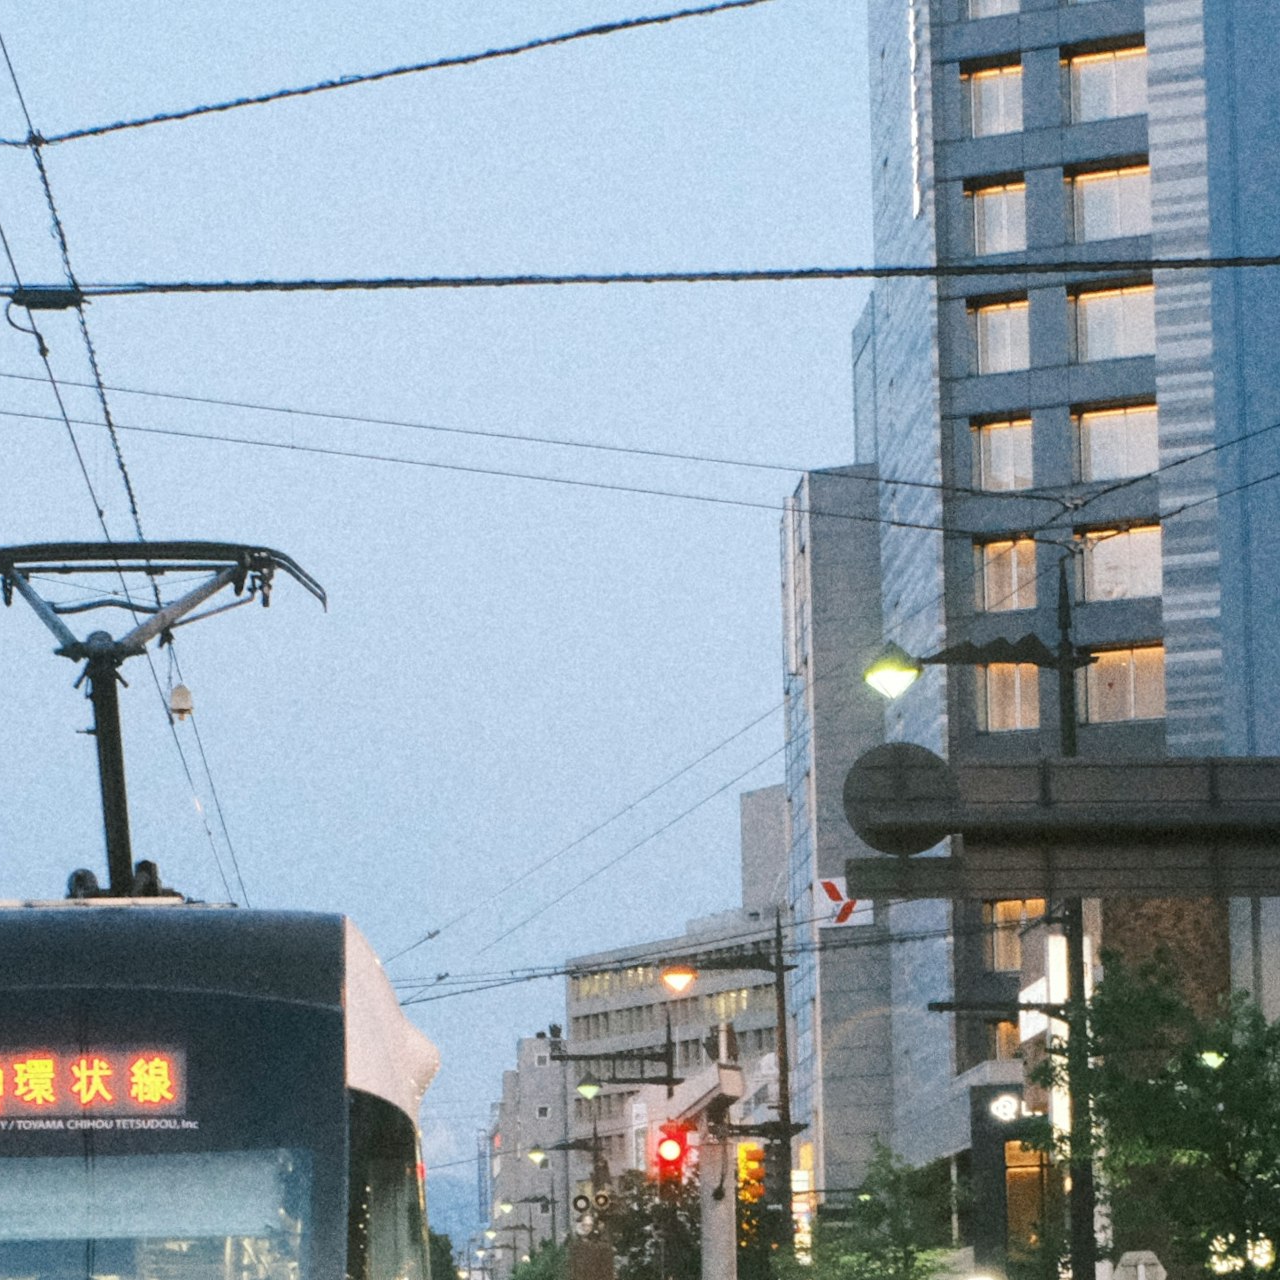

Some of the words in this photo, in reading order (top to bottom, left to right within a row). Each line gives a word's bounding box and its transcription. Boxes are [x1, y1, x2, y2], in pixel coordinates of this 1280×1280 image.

[14, 1057, 174, 1104] 環状線
[17, 1119, 64, 1130] TOYAMA
[67, 1119, 114, 1130] CHIHOU
